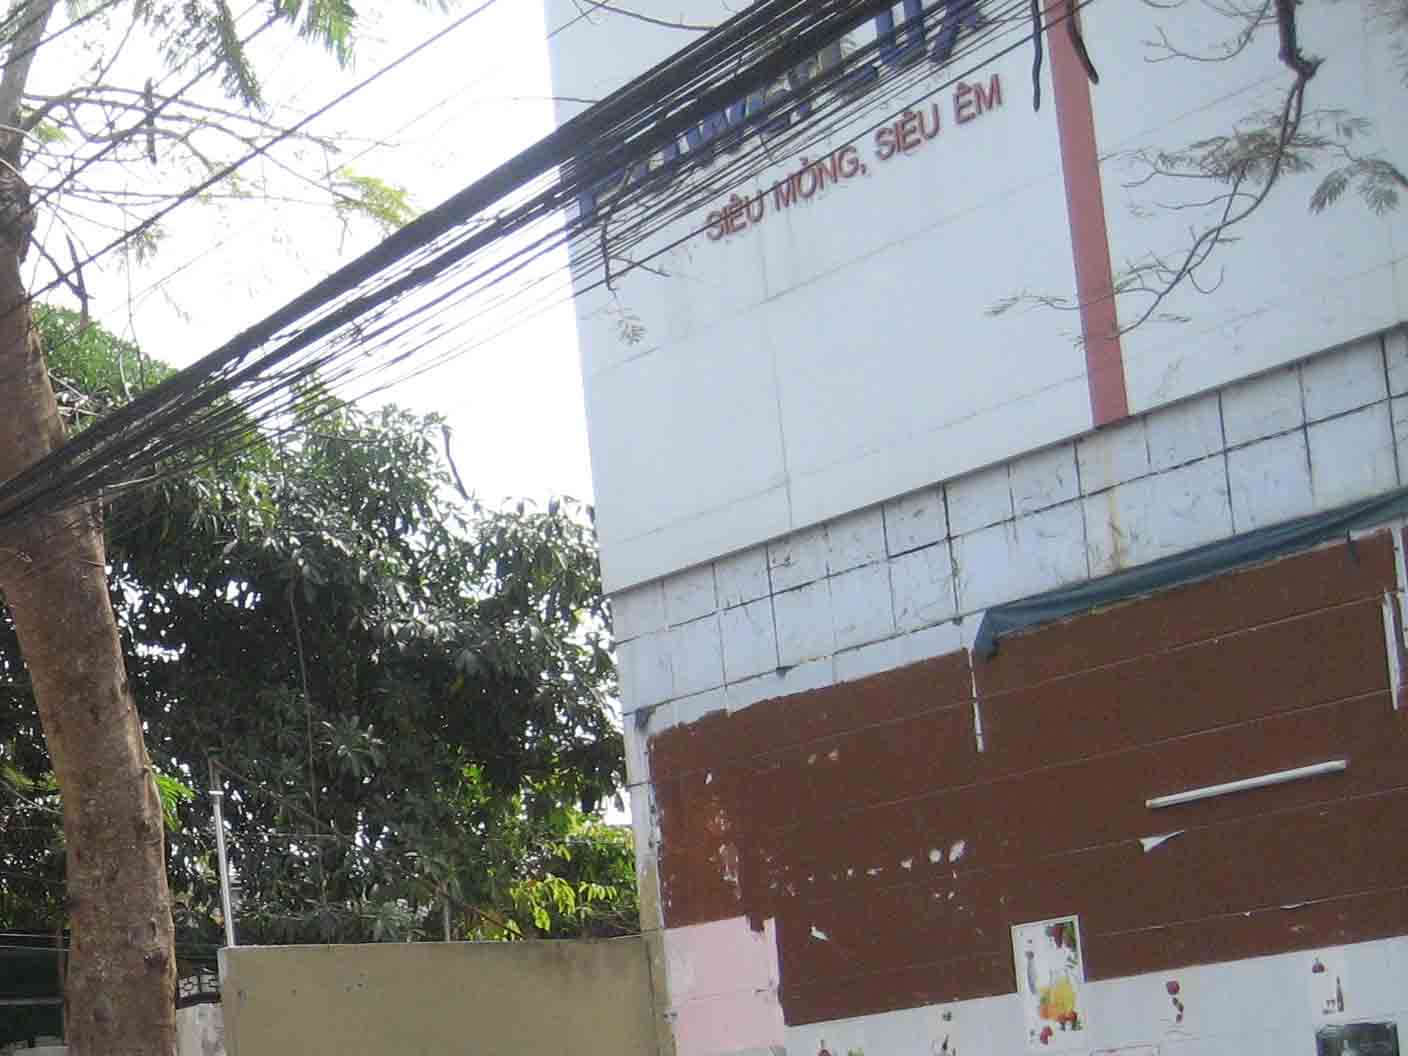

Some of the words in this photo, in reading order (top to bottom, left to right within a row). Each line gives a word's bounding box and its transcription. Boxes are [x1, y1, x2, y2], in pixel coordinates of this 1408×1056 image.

[705, 189, 764, 240] SIÊU
[875, 103, 940, 160] SIÊU
[953, 74, 1002, 124] ÊM
